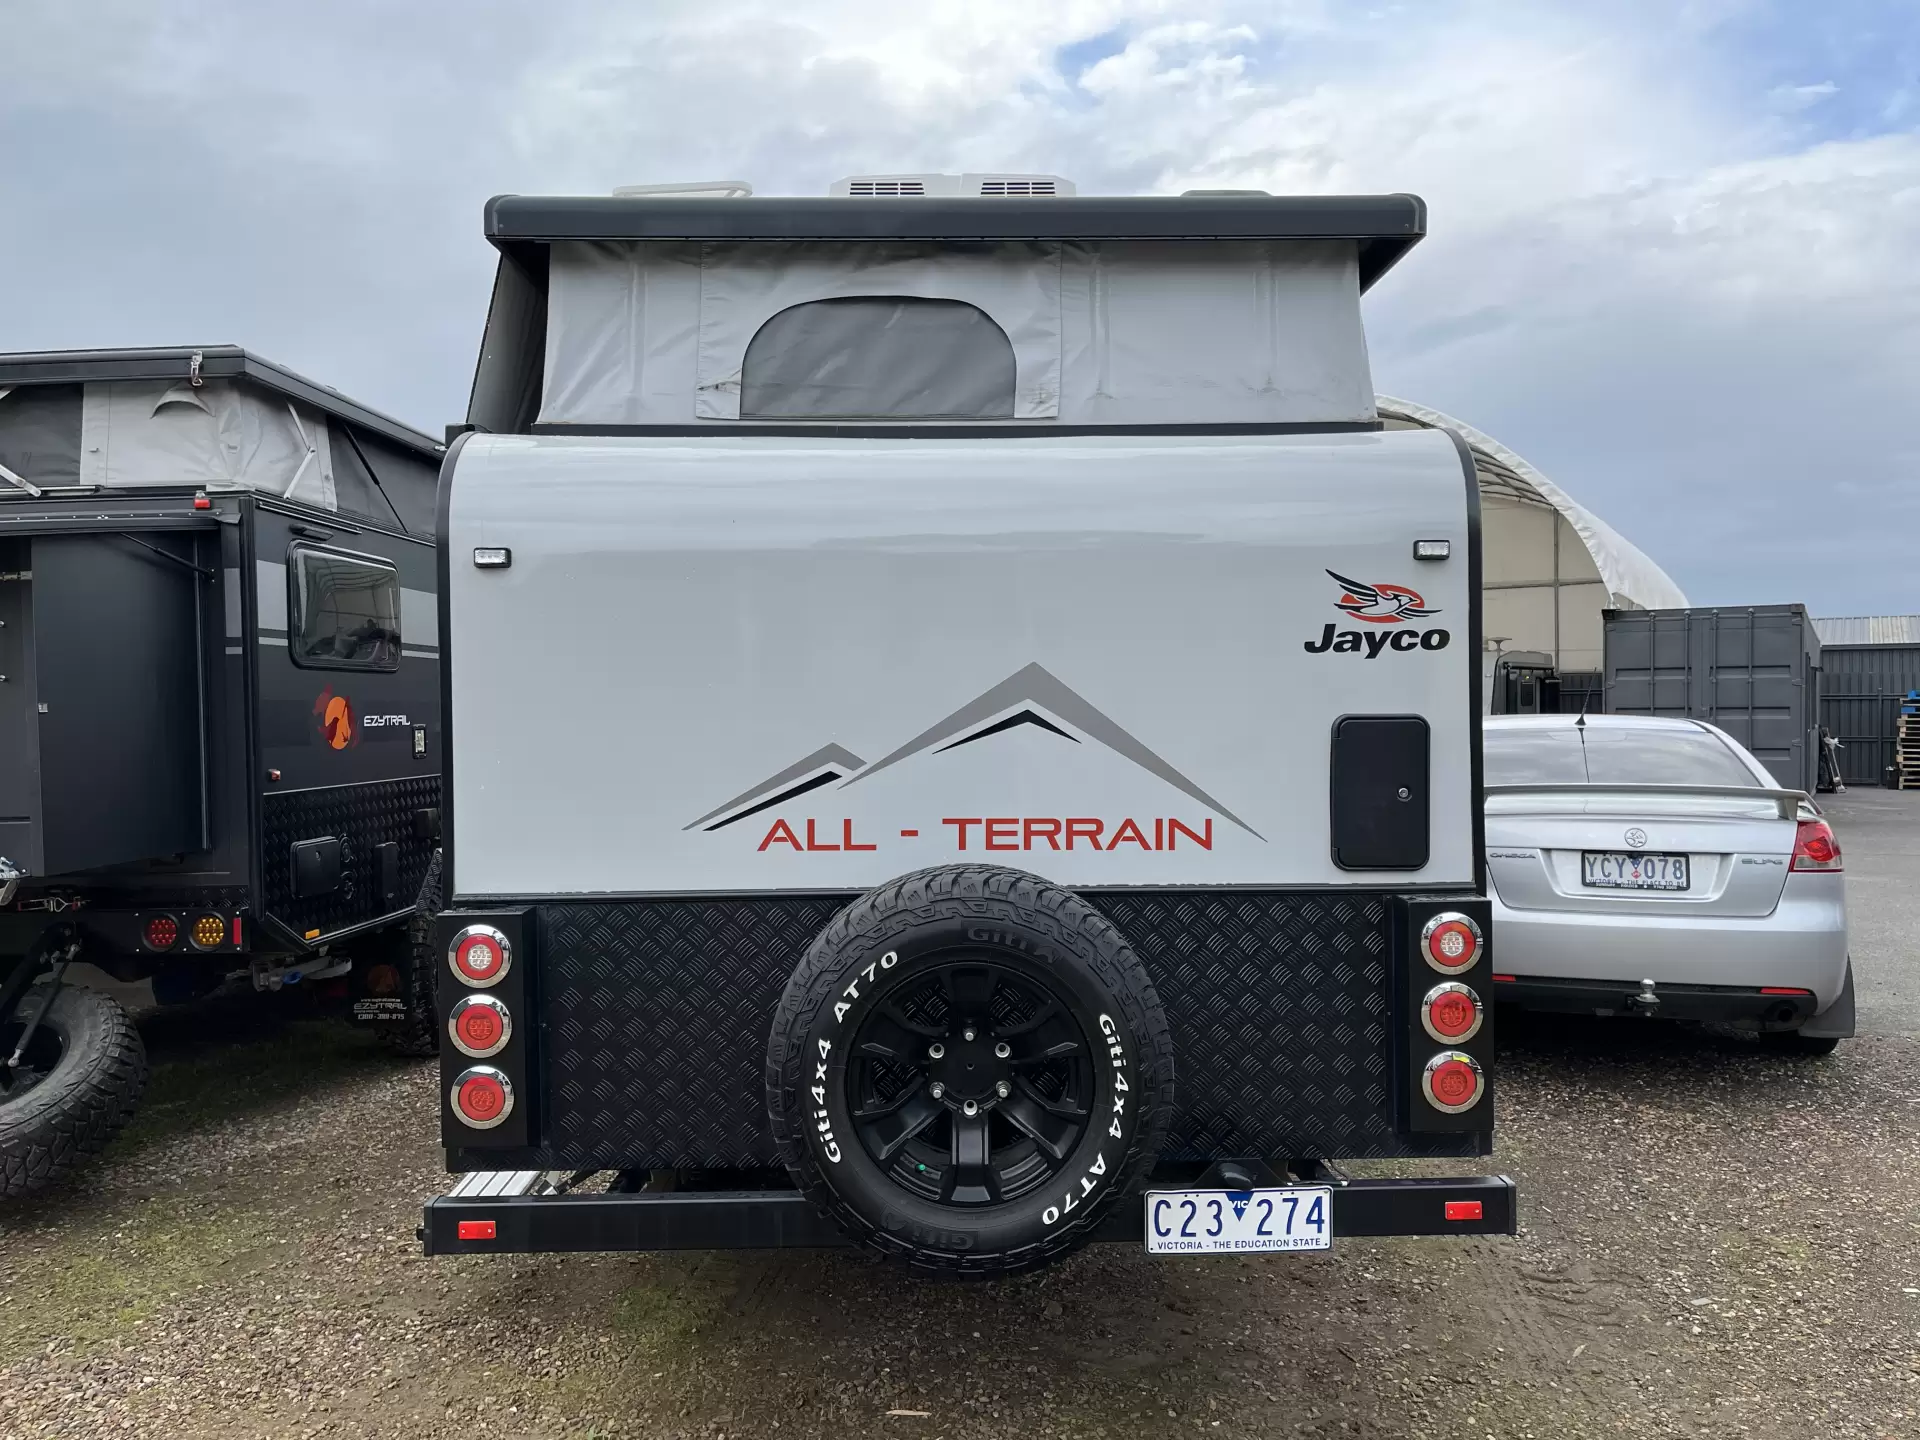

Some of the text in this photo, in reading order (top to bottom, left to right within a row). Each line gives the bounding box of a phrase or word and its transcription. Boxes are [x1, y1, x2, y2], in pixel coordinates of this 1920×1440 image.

[1304, 623, 1450, 659] Jayco
[757, 818, 877, 851] ALL
[942, 818, 1212, 851] TERRAIN
[1586, 856, 1684, 880] YCY 078
[967, 927, 1028, 950] Giti
[833, 951, 898, 1024] AT70
[1042, 1153, 1107, 1225] AT70
[1229, 1200, 1250, 1209] VIC
[1154, 1195, 1325, 1238] C23 274
[1157, 1241, 1203, 1250] VICTORIA
[1213, 1240, 1231, 1249] THE
[1235, 1239, 1290, 1249] EDUCATION
[1292, 1238, 1321, 1247] STATE
